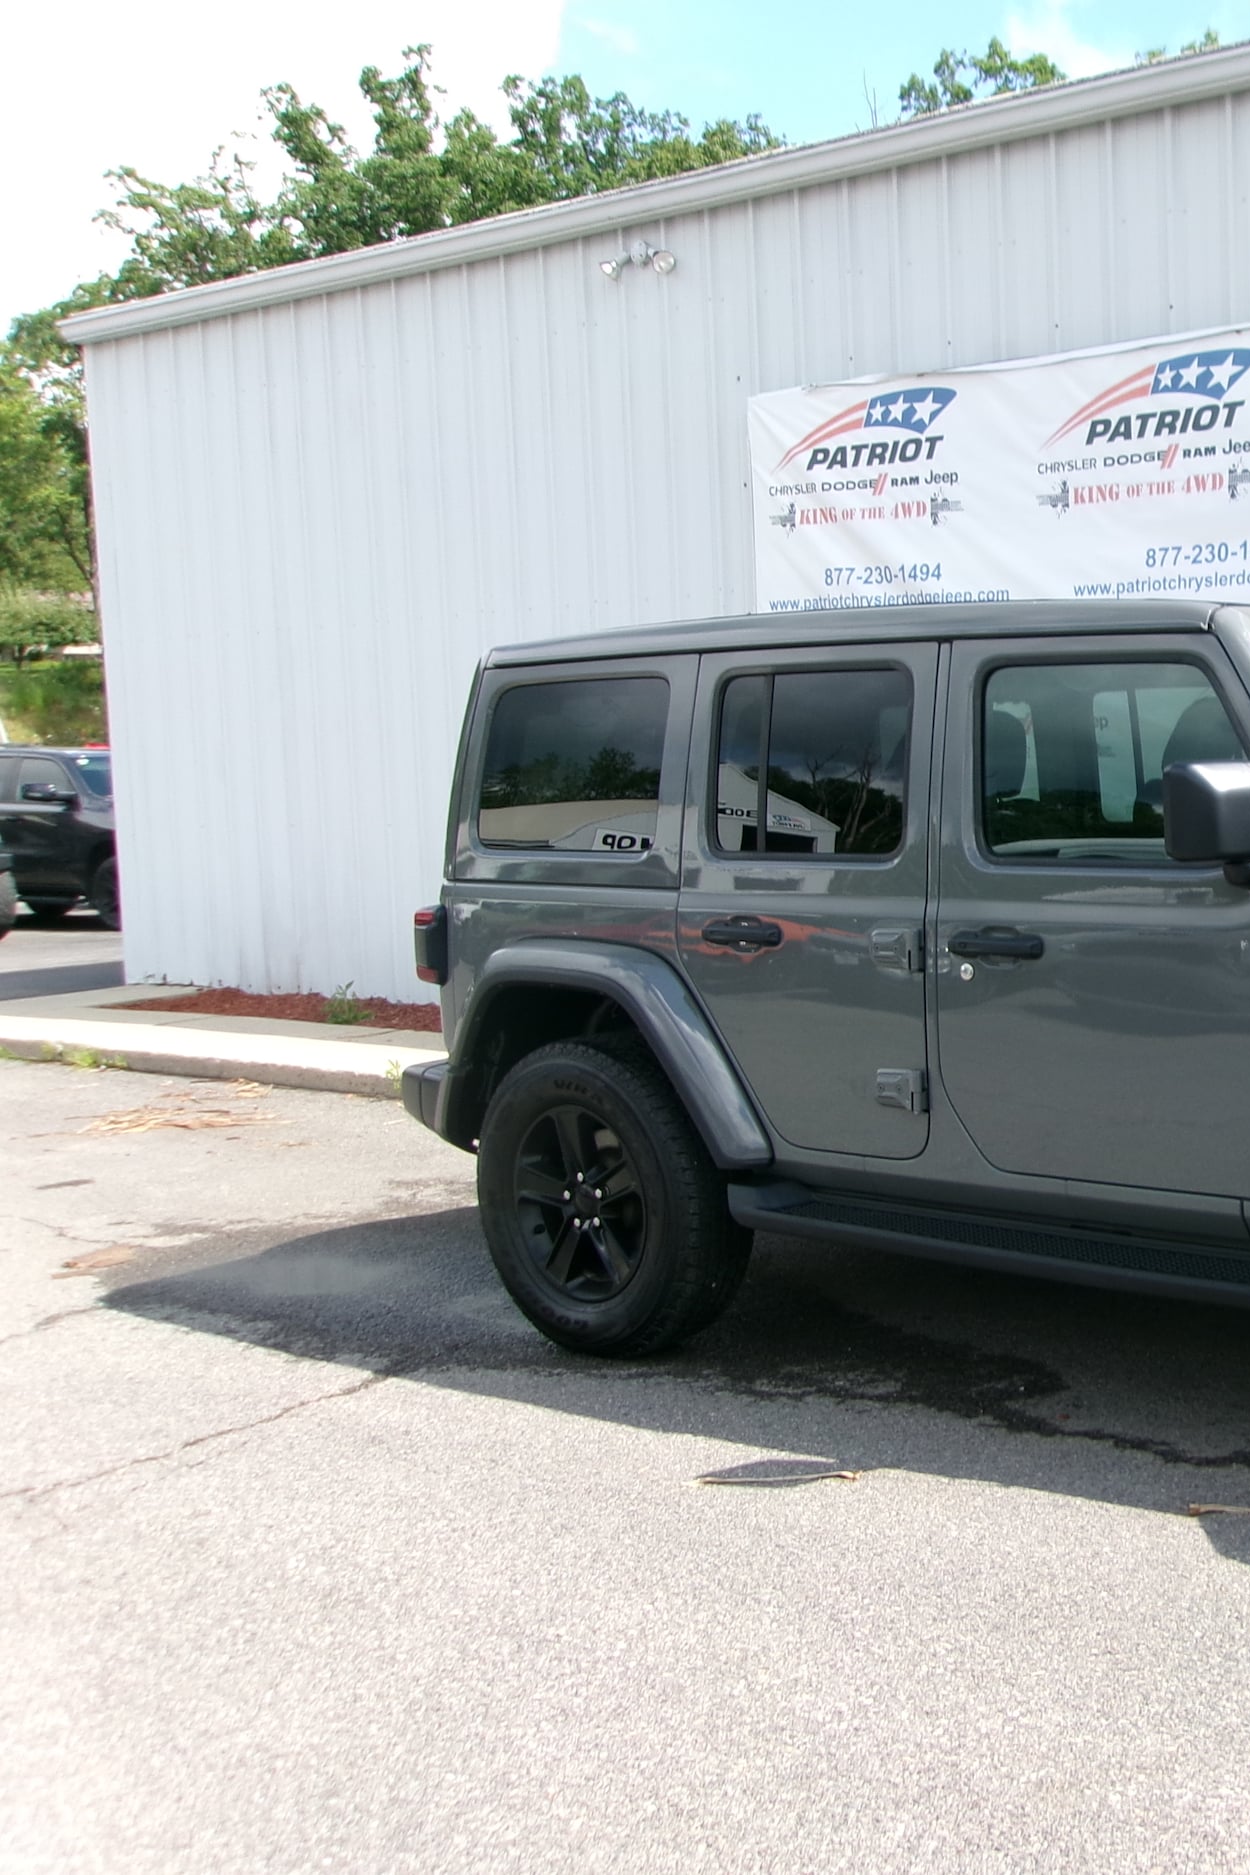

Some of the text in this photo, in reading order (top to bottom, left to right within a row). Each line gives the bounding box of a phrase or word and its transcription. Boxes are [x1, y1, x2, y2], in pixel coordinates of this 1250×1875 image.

[1085, 400, 1246, 446] PATRIOT
[806, 435, 944, 471] PATRIOT
[1037, 458, 1097, 475] CHRYSLER
[1103, 450, 1167, 467] DODGE
[1182, 446, 1217, 459] RAM
[769, 470, 959, 497] CHRYSLER DODGE RAM Jeep
[1073, 472, 1225, 505] KING OF THE 4WD
[800, 501, 927, 525] KING OF THE 4WD
[824, 563, 942, 586] 877-230-1494
